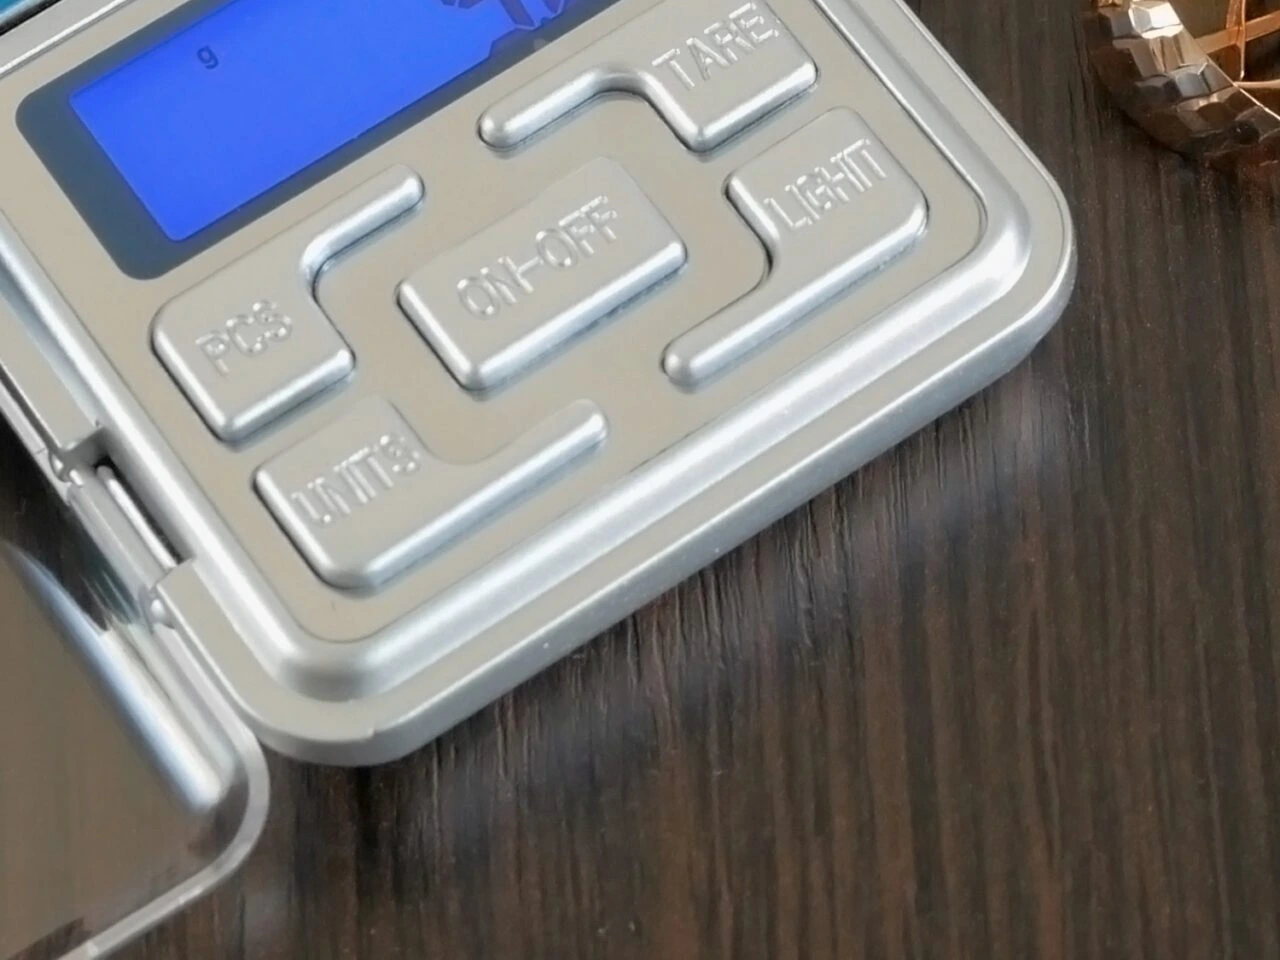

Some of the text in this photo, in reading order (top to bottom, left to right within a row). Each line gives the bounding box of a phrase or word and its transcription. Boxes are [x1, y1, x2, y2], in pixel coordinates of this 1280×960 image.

[196, 45, 219, 70] g
[651, 1, 779, 91] TARE
[763, 138, 887, 229] LIGHT
[457, 195, 618, 320] ON-OFF
[195, 299, 293, 378] PCS
[291, 434, 421, 526] UNITS
